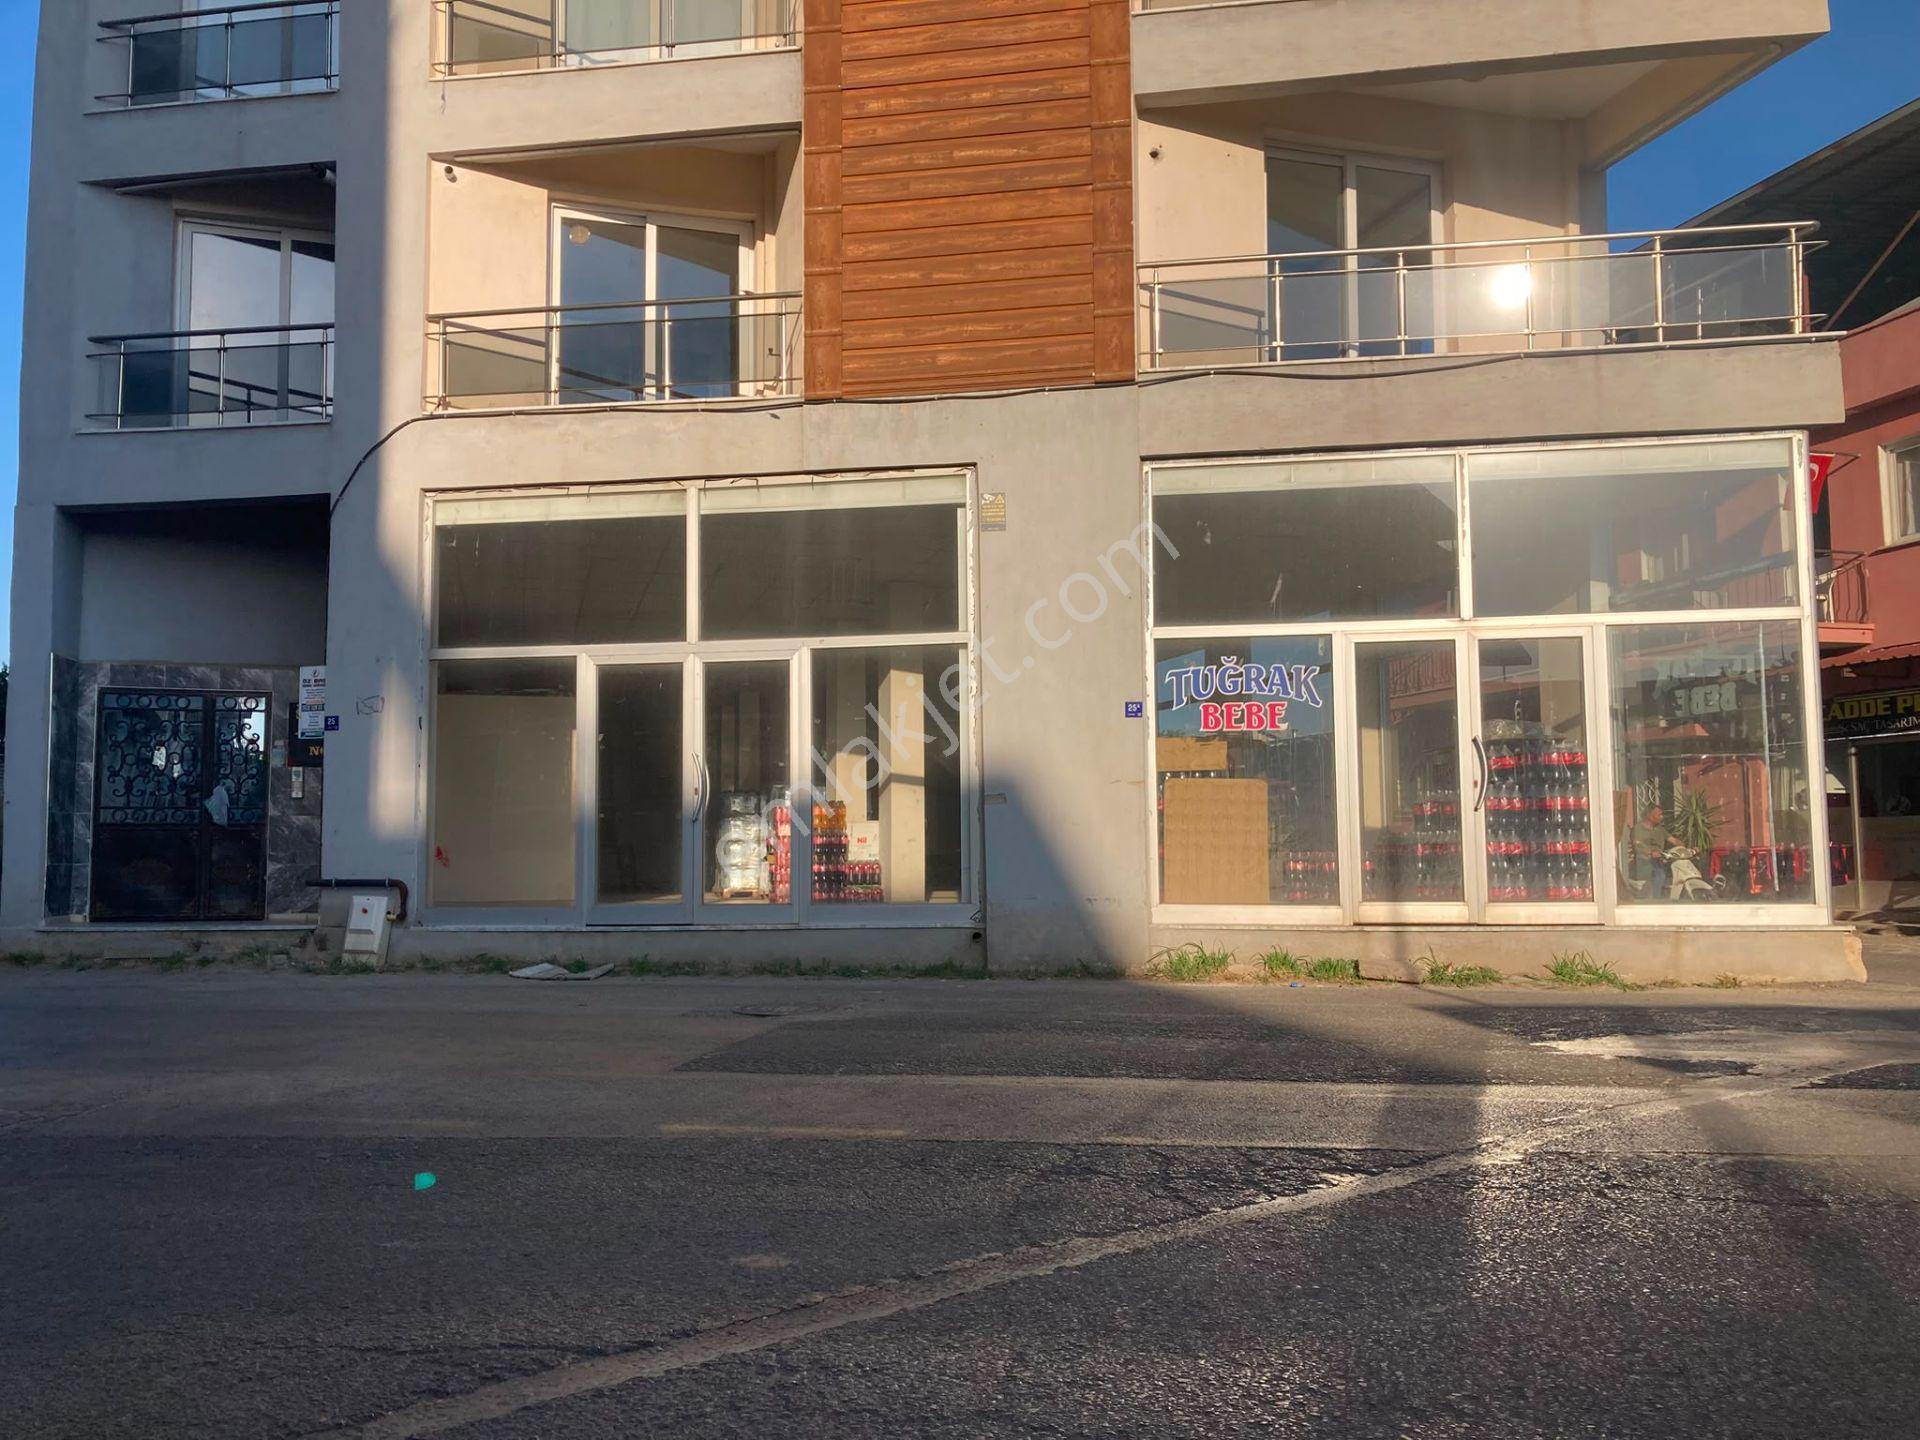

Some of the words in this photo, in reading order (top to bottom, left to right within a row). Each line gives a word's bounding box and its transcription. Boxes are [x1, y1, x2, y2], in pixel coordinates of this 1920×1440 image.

[1165, 656, 1322, 711] TUĞRAK
[1200, 702, 1288, 732] BEBE
[1824, 697, 1891, 720] ADDE
